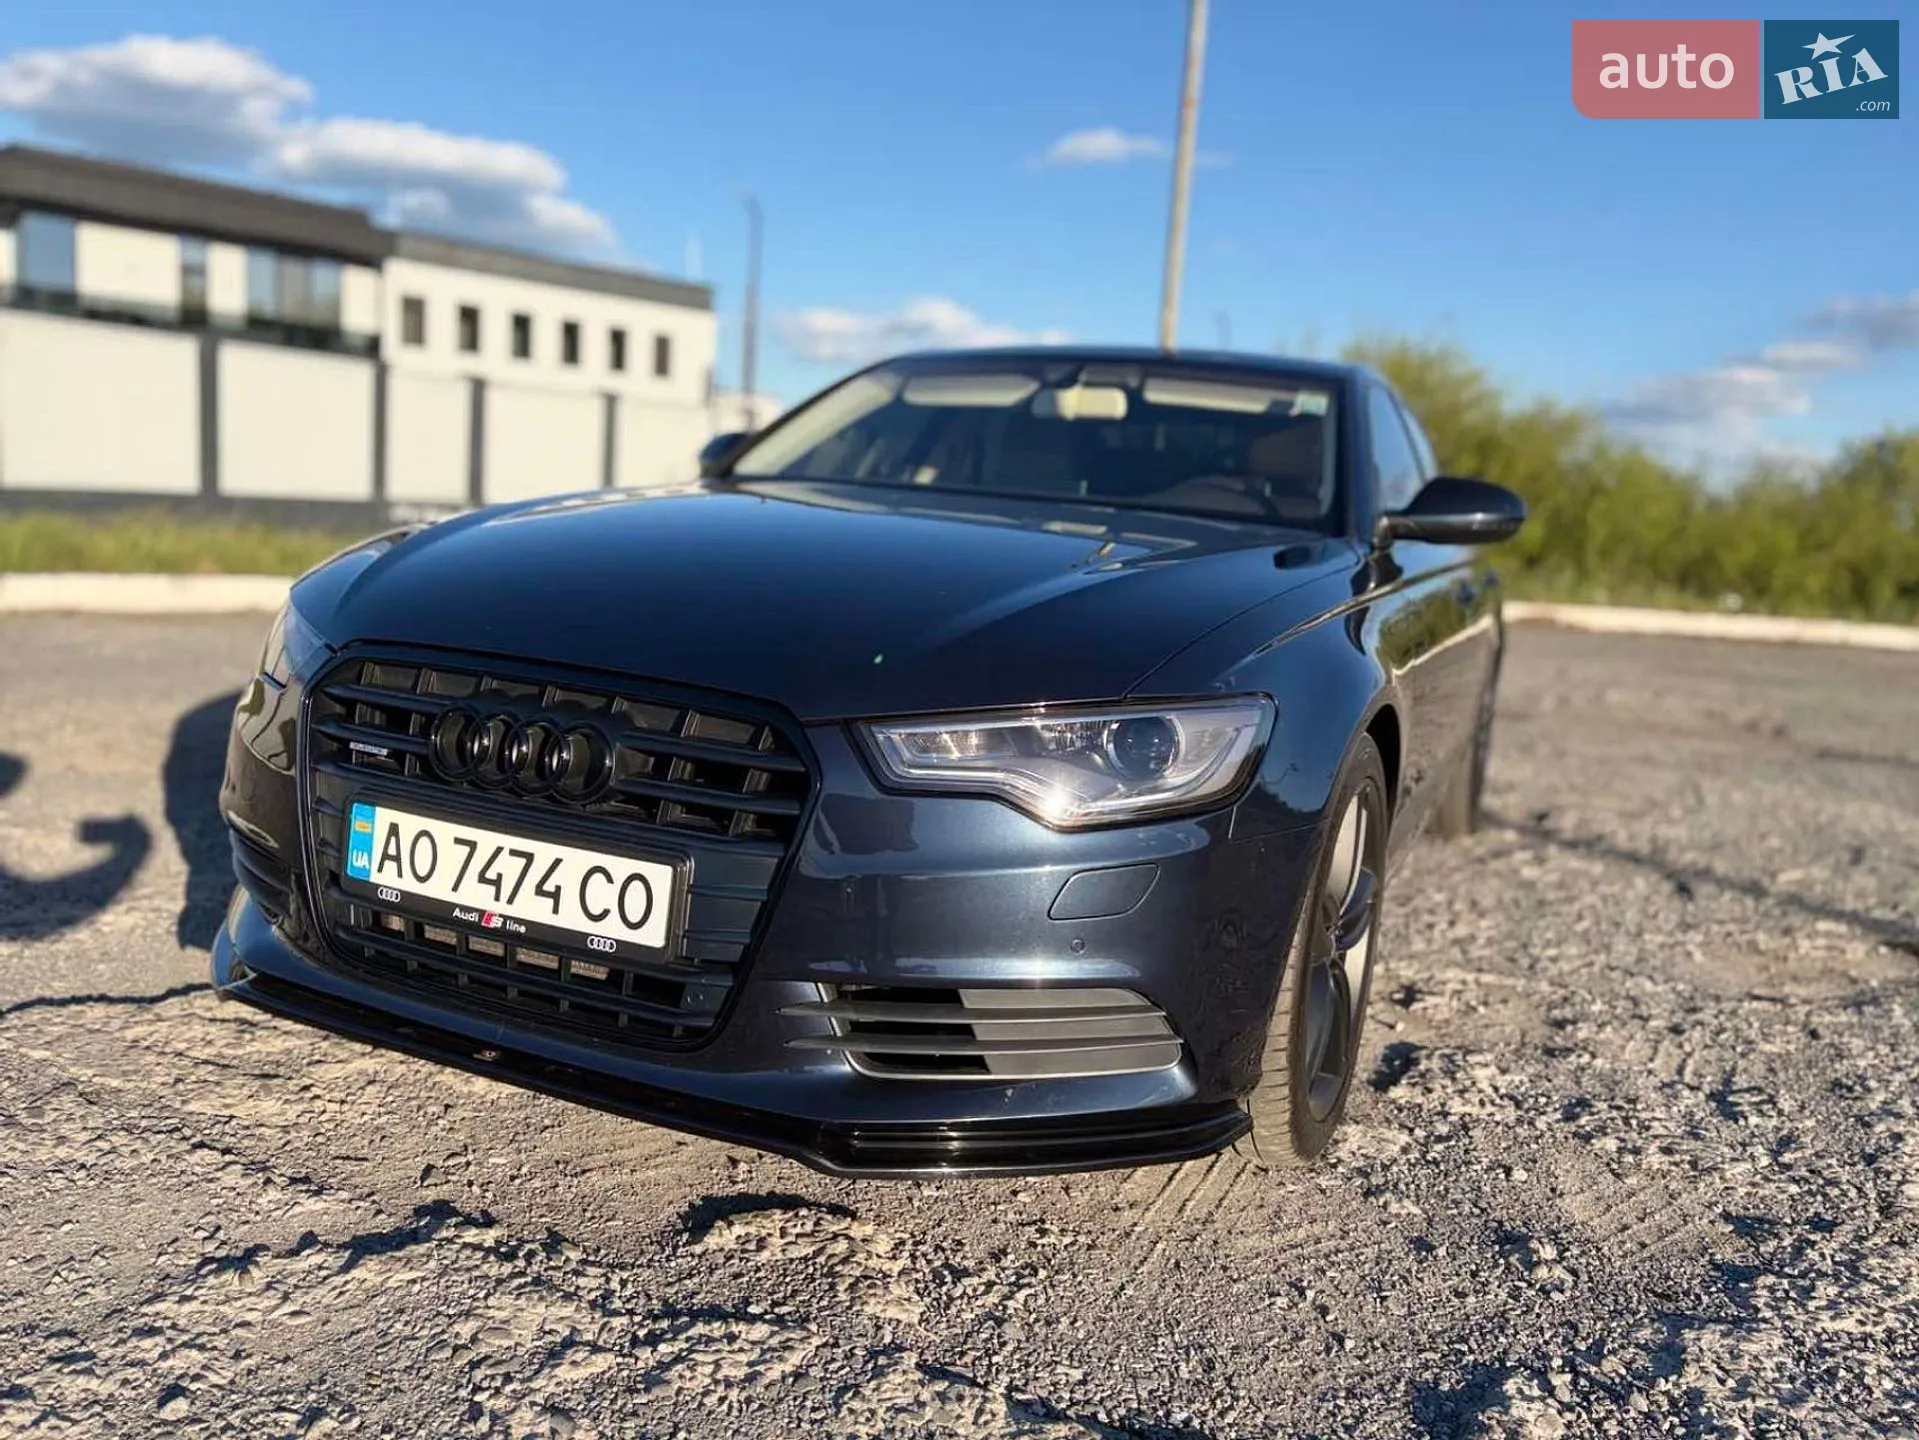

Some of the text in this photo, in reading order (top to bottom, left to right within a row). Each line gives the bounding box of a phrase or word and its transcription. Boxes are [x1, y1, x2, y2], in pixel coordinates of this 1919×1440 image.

[352, 849, 370, 870] UA
[377, 822, 653, 930] AO 7474 CO
[453, 907, 479, 922] Audi
[506, 920, 526, 934] line
